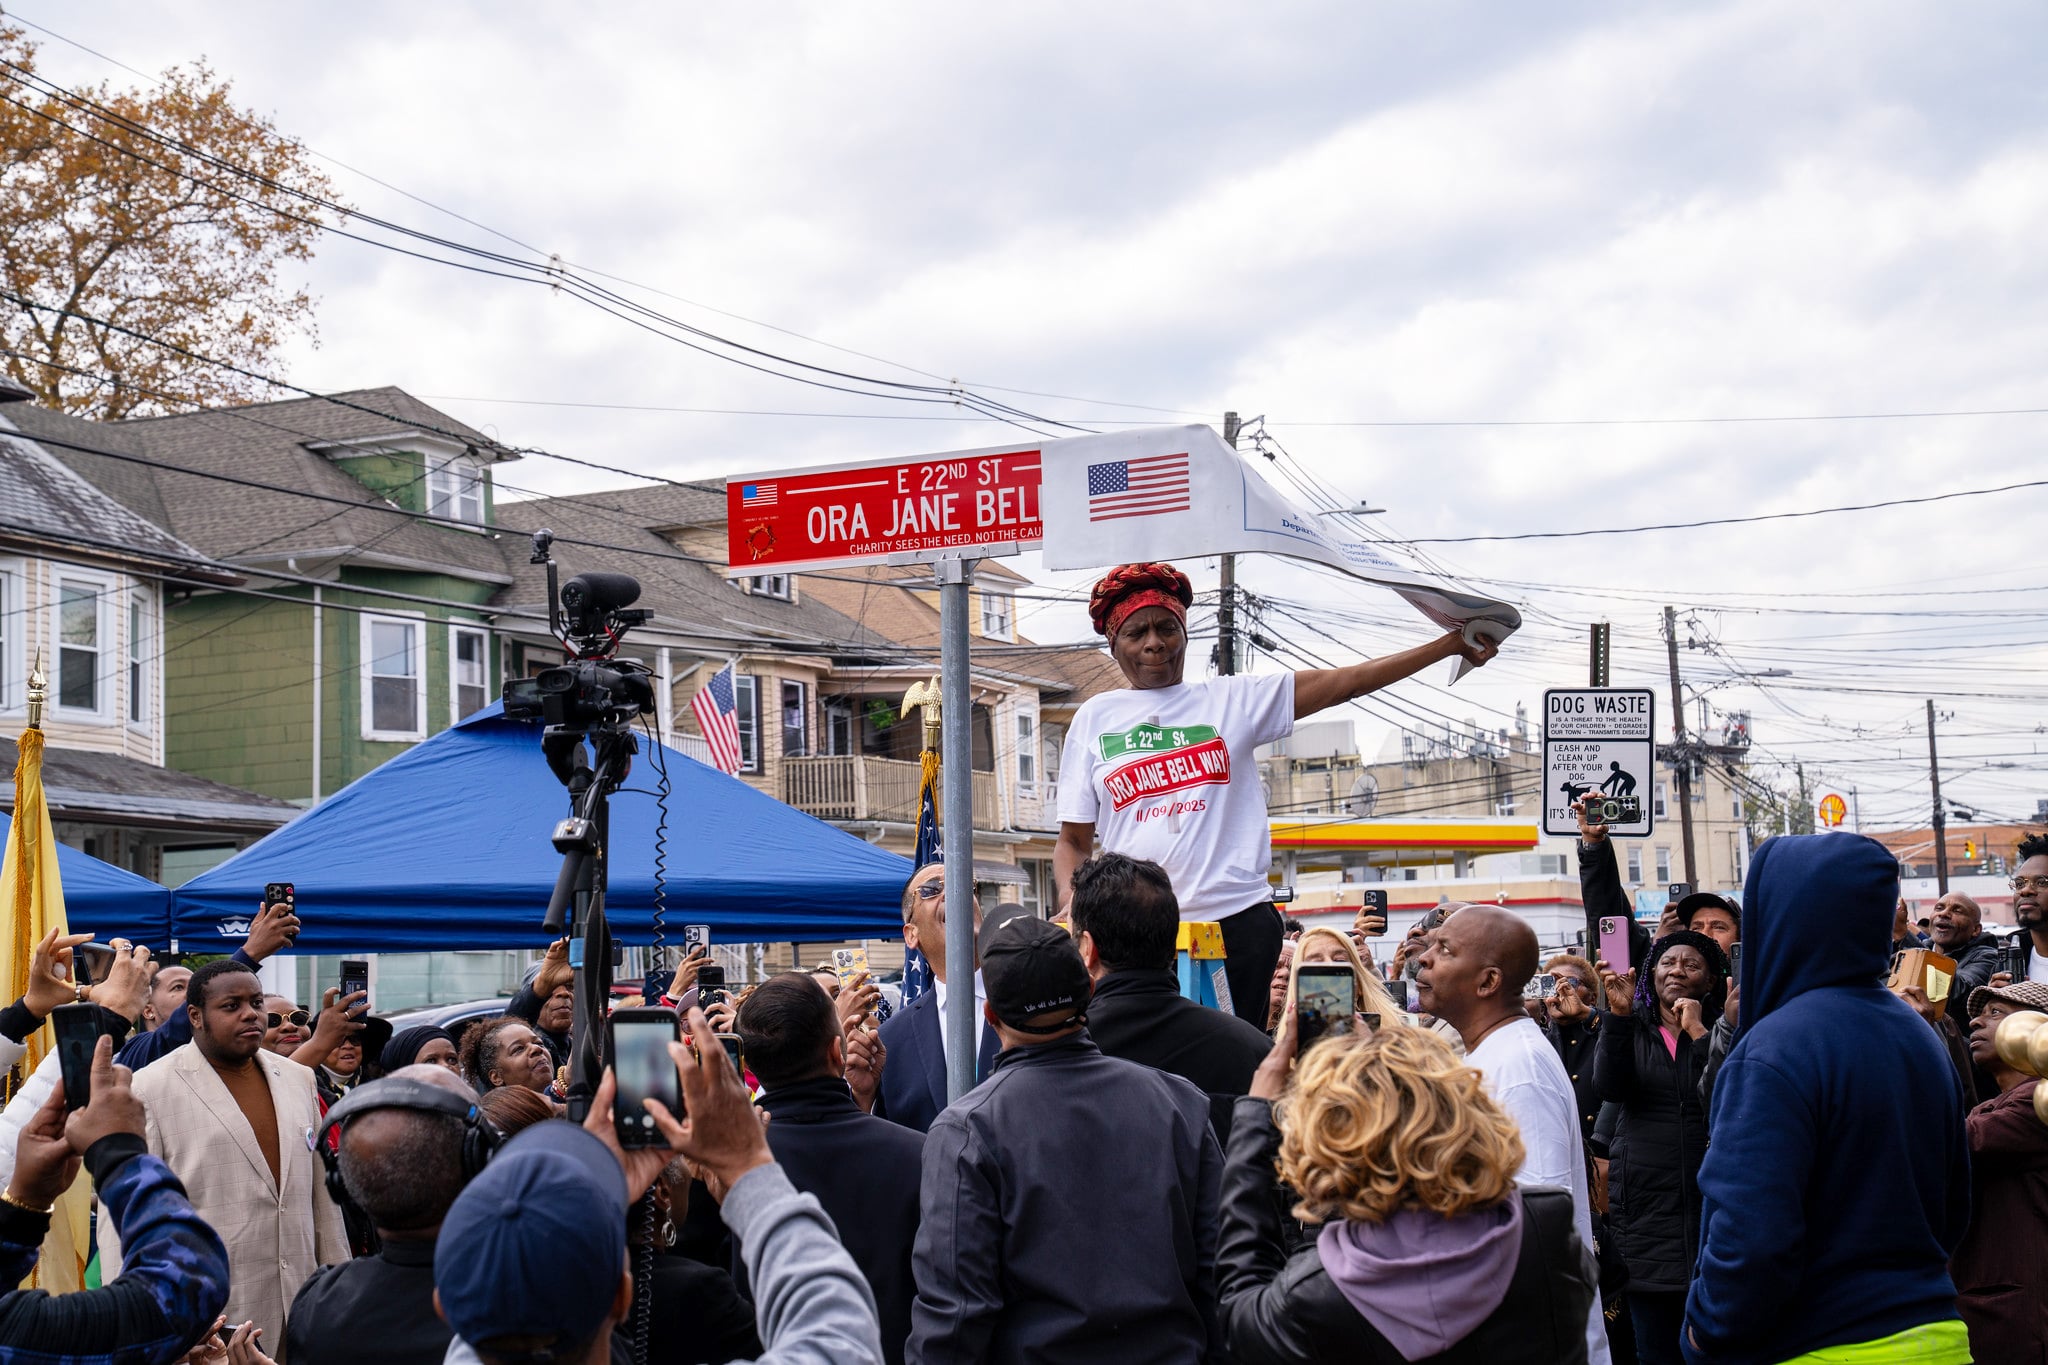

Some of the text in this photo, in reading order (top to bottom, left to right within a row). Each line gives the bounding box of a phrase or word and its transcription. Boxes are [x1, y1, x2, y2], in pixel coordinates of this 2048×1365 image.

[897, 458, 1003, 494] E 22ND ST
[807, 502, 870, 544] ORA
[882, 492, 961, 537] JANE
[849, 541, 893, 555] CHARITY
[895, 538, 921, 551] SEES
[923, 535, 942, 548] THE
[975, 530, 996, 543] NOT
[998, 528, 1018, 541] THE
[1019, 526, 1043, 539] CAU
[1551, 696, 1647, 714] DOG WASTE
[1125, 730, 1190, 750] E. 22nd St.
[1554, 744, 1601, 752] LEASH AND
[1134, 761, 1169, 792] JANE
[1165, 755, 1203, 784] BELL
[1198, 749, 1227, 775] WAY
[1551, 763, 1603, 771] AFTER YOUR
[1136, 799, 1206, 823] 11/09/2025
[1549, 808, 1565, 819] IT'S
